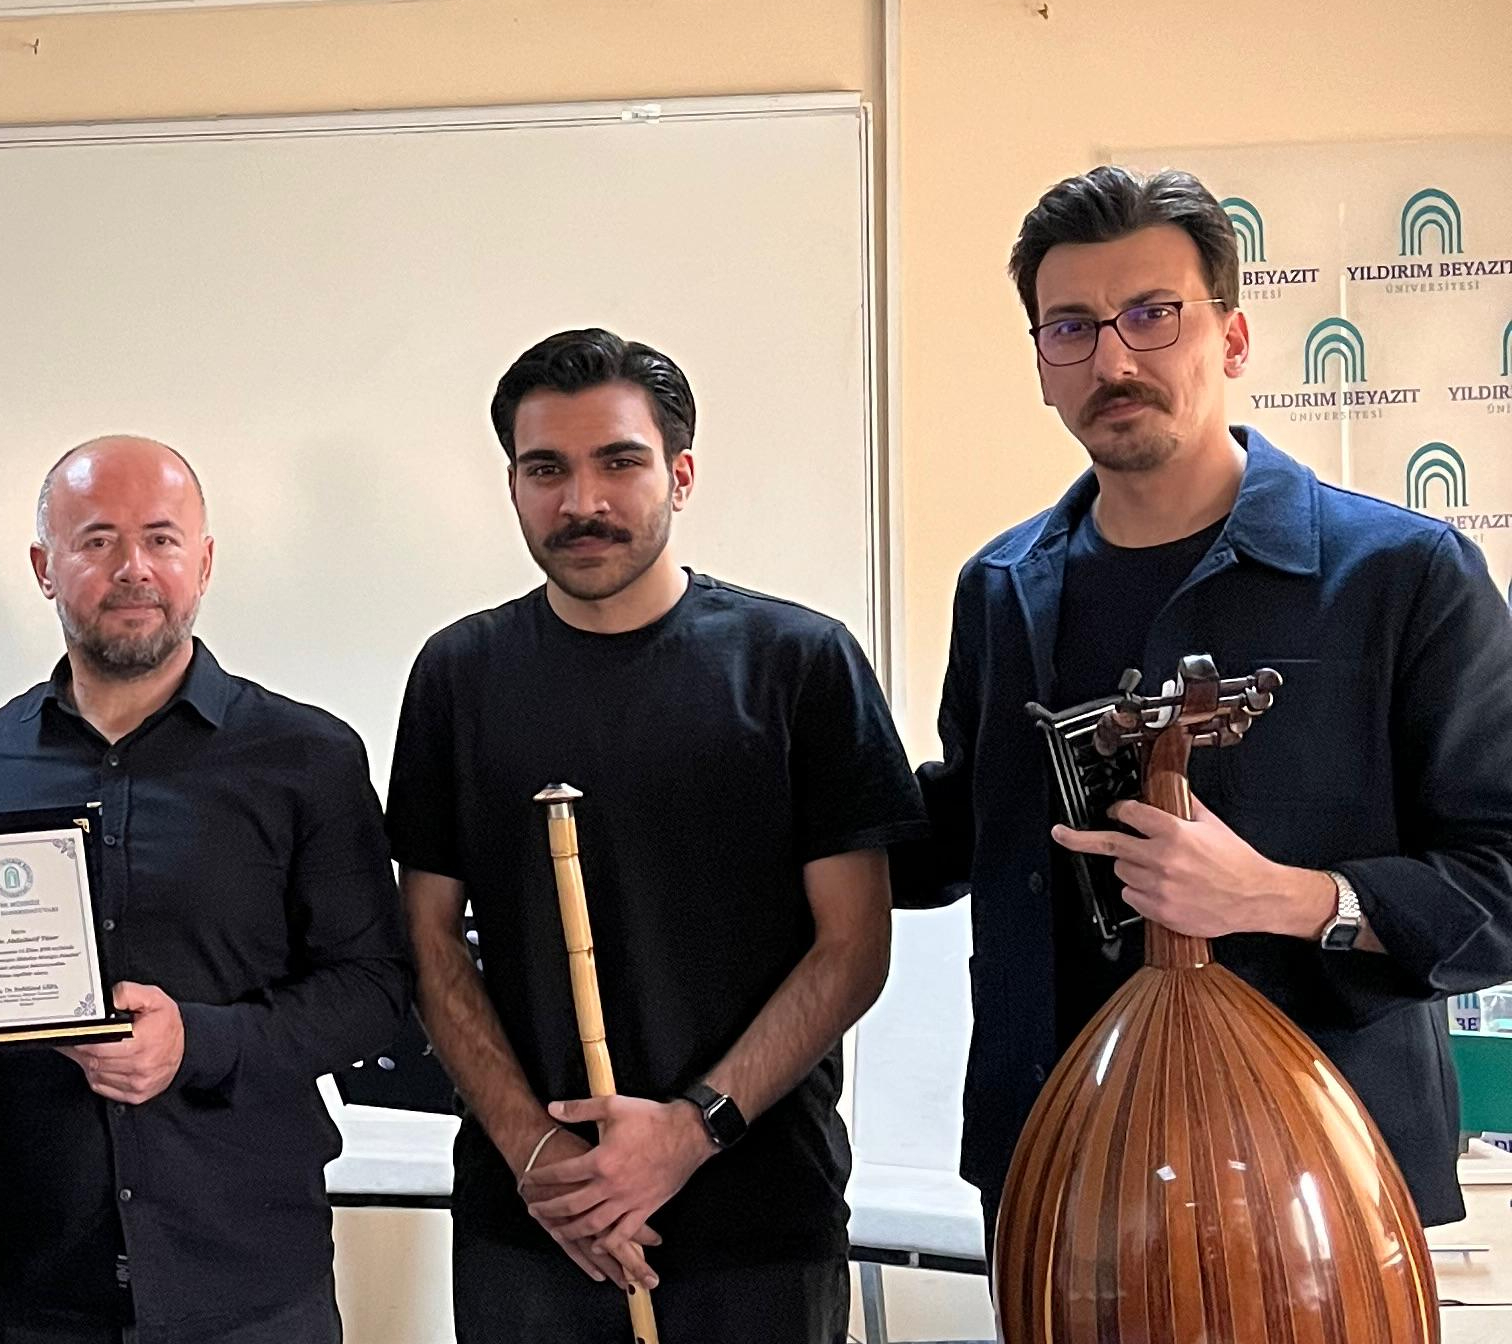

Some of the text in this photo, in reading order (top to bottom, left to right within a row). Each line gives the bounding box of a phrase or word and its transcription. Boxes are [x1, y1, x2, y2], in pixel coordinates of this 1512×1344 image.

[1242, 267, 1320, 286] BEYAZIT
[1346, 263, 1432, 281] YILDIRIM
[1250, 388, 1421, 409] YILDIRIM BEYAZIT
